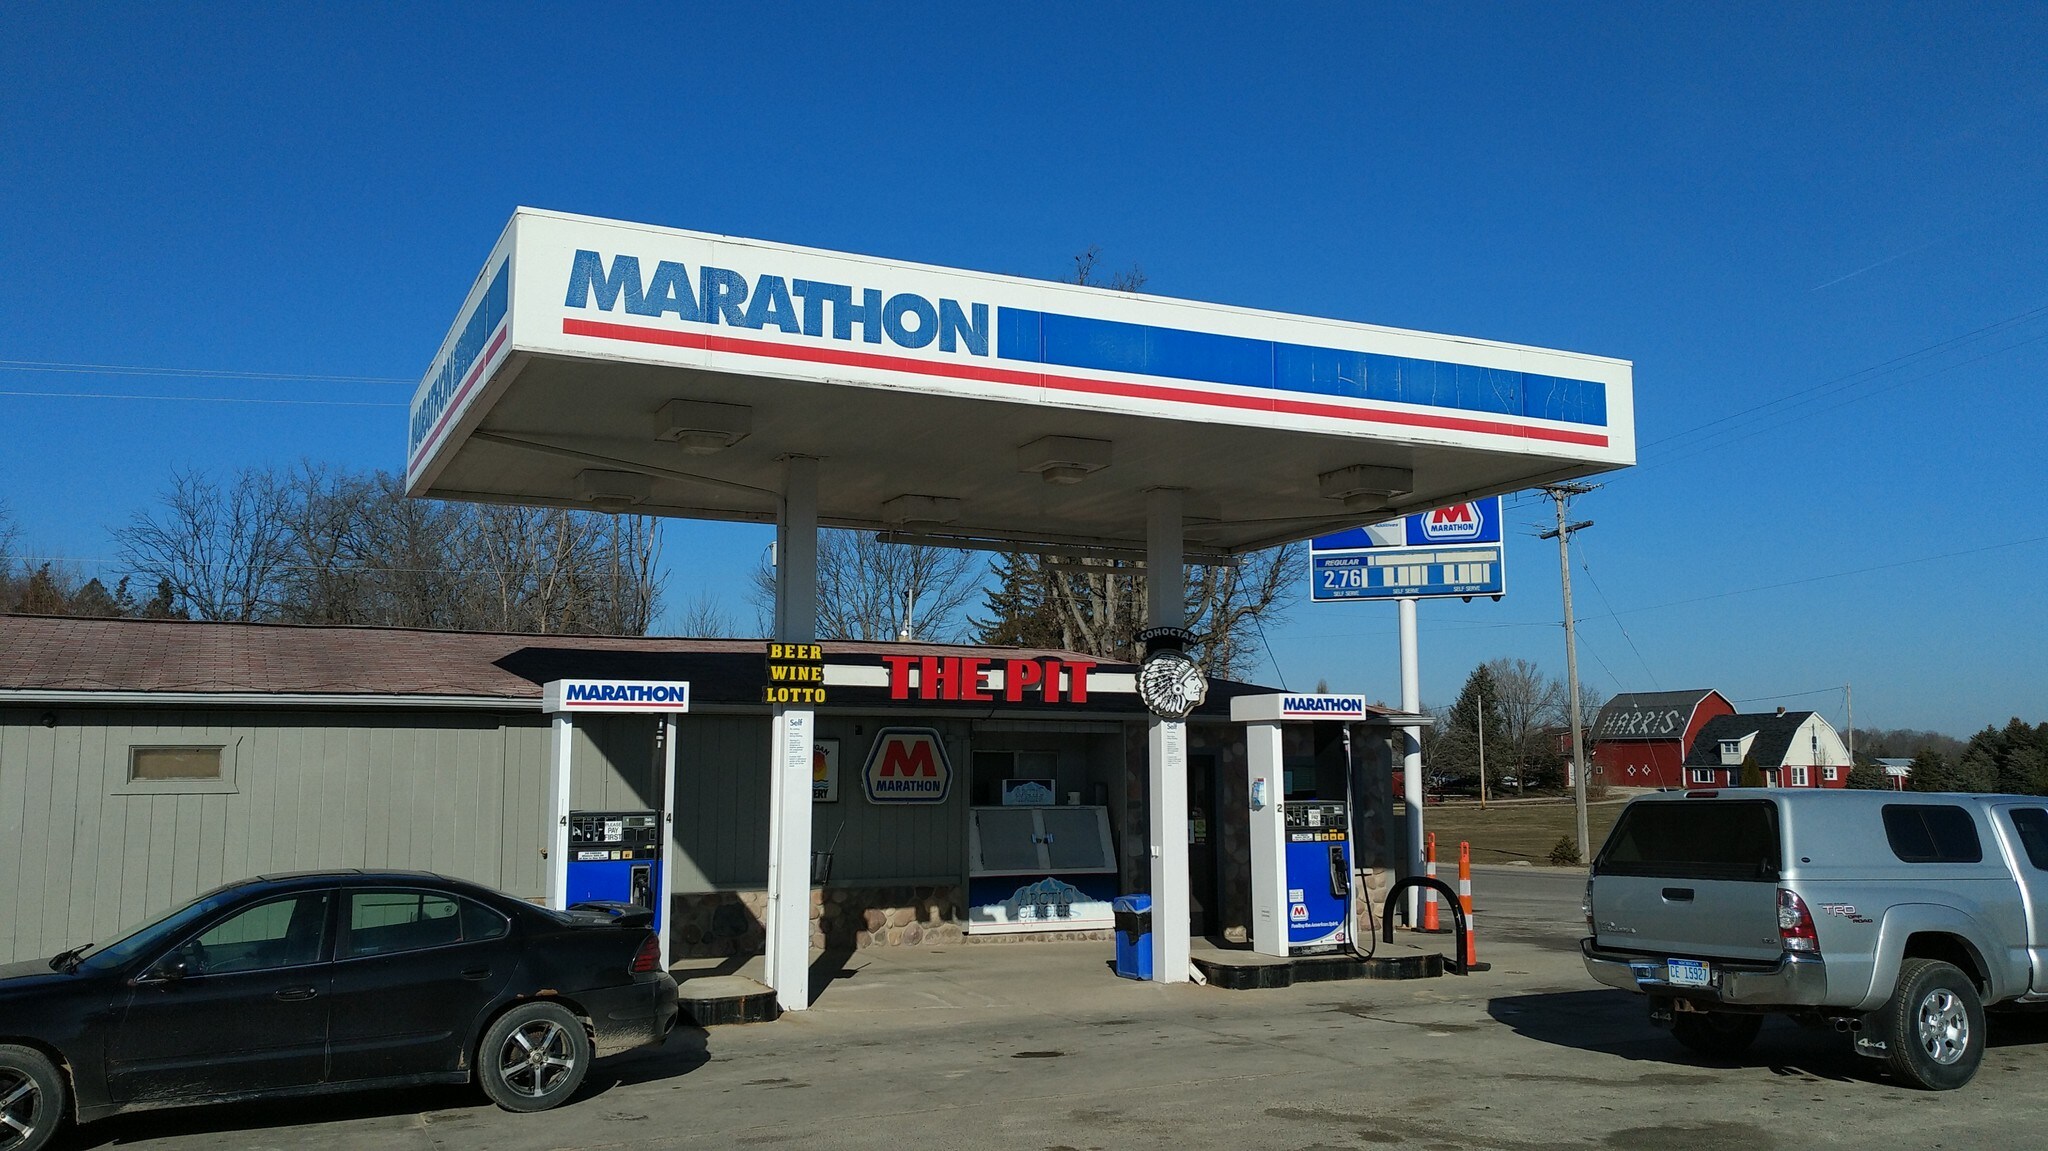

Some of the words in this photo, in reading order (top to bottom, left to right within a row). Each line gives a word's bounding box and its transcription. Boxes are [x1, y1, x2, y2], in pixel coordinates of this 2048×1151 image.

[565, 249, 989, 357] MARATHON
[1431, 523, 1474, 532] MARATHON
[1325, 558, 1360, 567] REGULAR
[1324, 569, 1361, 588] 2.76
[1140, 627, 1198, 643] COHOCTAH
[770, 644, 822, 659] BEER
[770, 665, 822, 680] WINE
[882, 656, 994, 701] THE
[1006, 659, 1097, 704] PIT
[566, 684, 684, 702] MARATHON
[766, 687, 826, 703] LOTTO
[1283, 697, 1362, 712] MARATHON
[1600, 710, 1680, 735] HARRIS
[880, 740, 938, 777] M
[876, 780, 941, 792] MARATHON
[1277, 804, 1283, 813] 2
[559, 816, 567, 826] 4
[665, 813, 672, 823] 4
[1018, 888, 1074, 906] ARCTIC
[1018, 905, 1072, 919] GLACIER
[1822, 905, 1856, 917] TRD
[1670, 966, 1680, 978] CE
[1684, 967, 1707, 981] 15927
